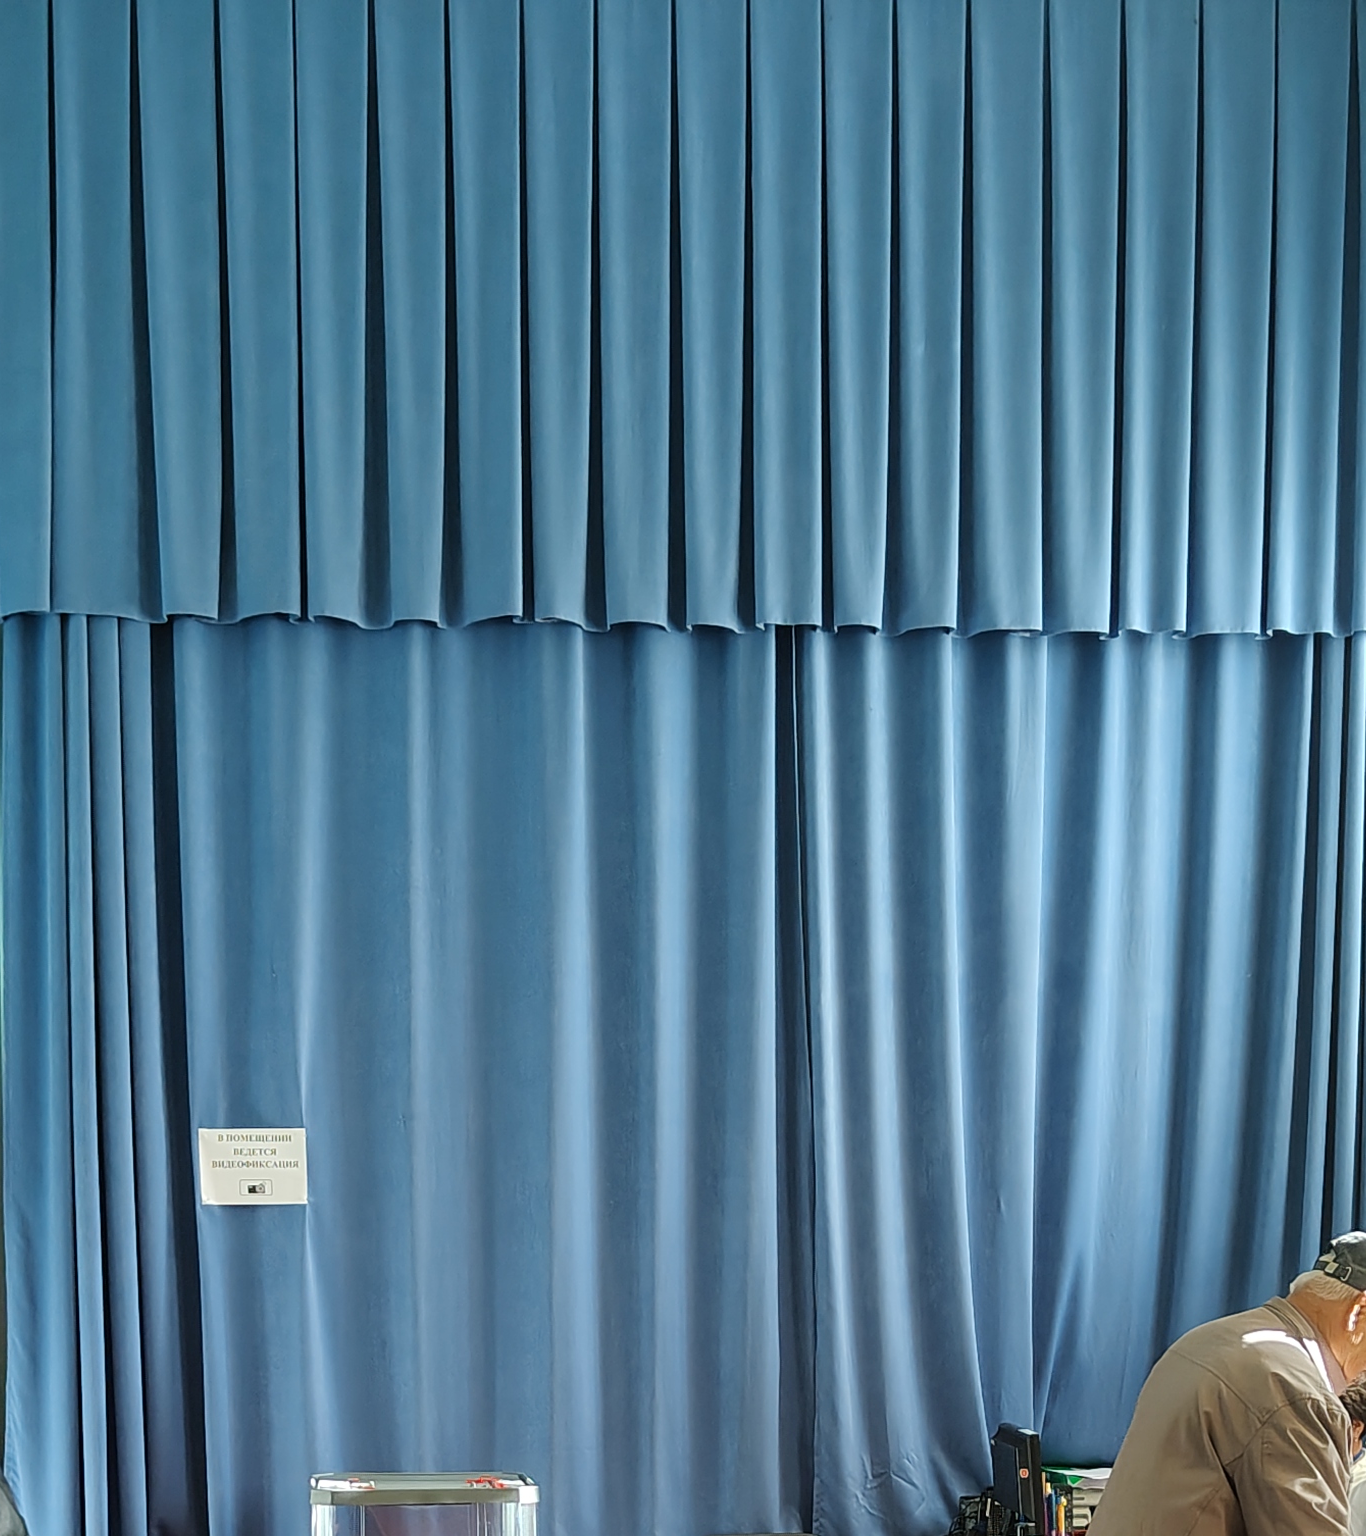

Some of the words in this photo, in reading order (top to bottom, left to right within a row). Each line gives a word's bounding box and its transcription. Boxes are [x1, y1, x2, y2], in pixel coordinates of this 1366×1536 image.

[226, 1133, 292, 1143] ПОМЕЩЕНИИ
[233, 1148, 277, 1157] ВЕДЕТСЯ
[212, 1160, 299, 1169] ВИДЕОФИКСАЦИЯ
